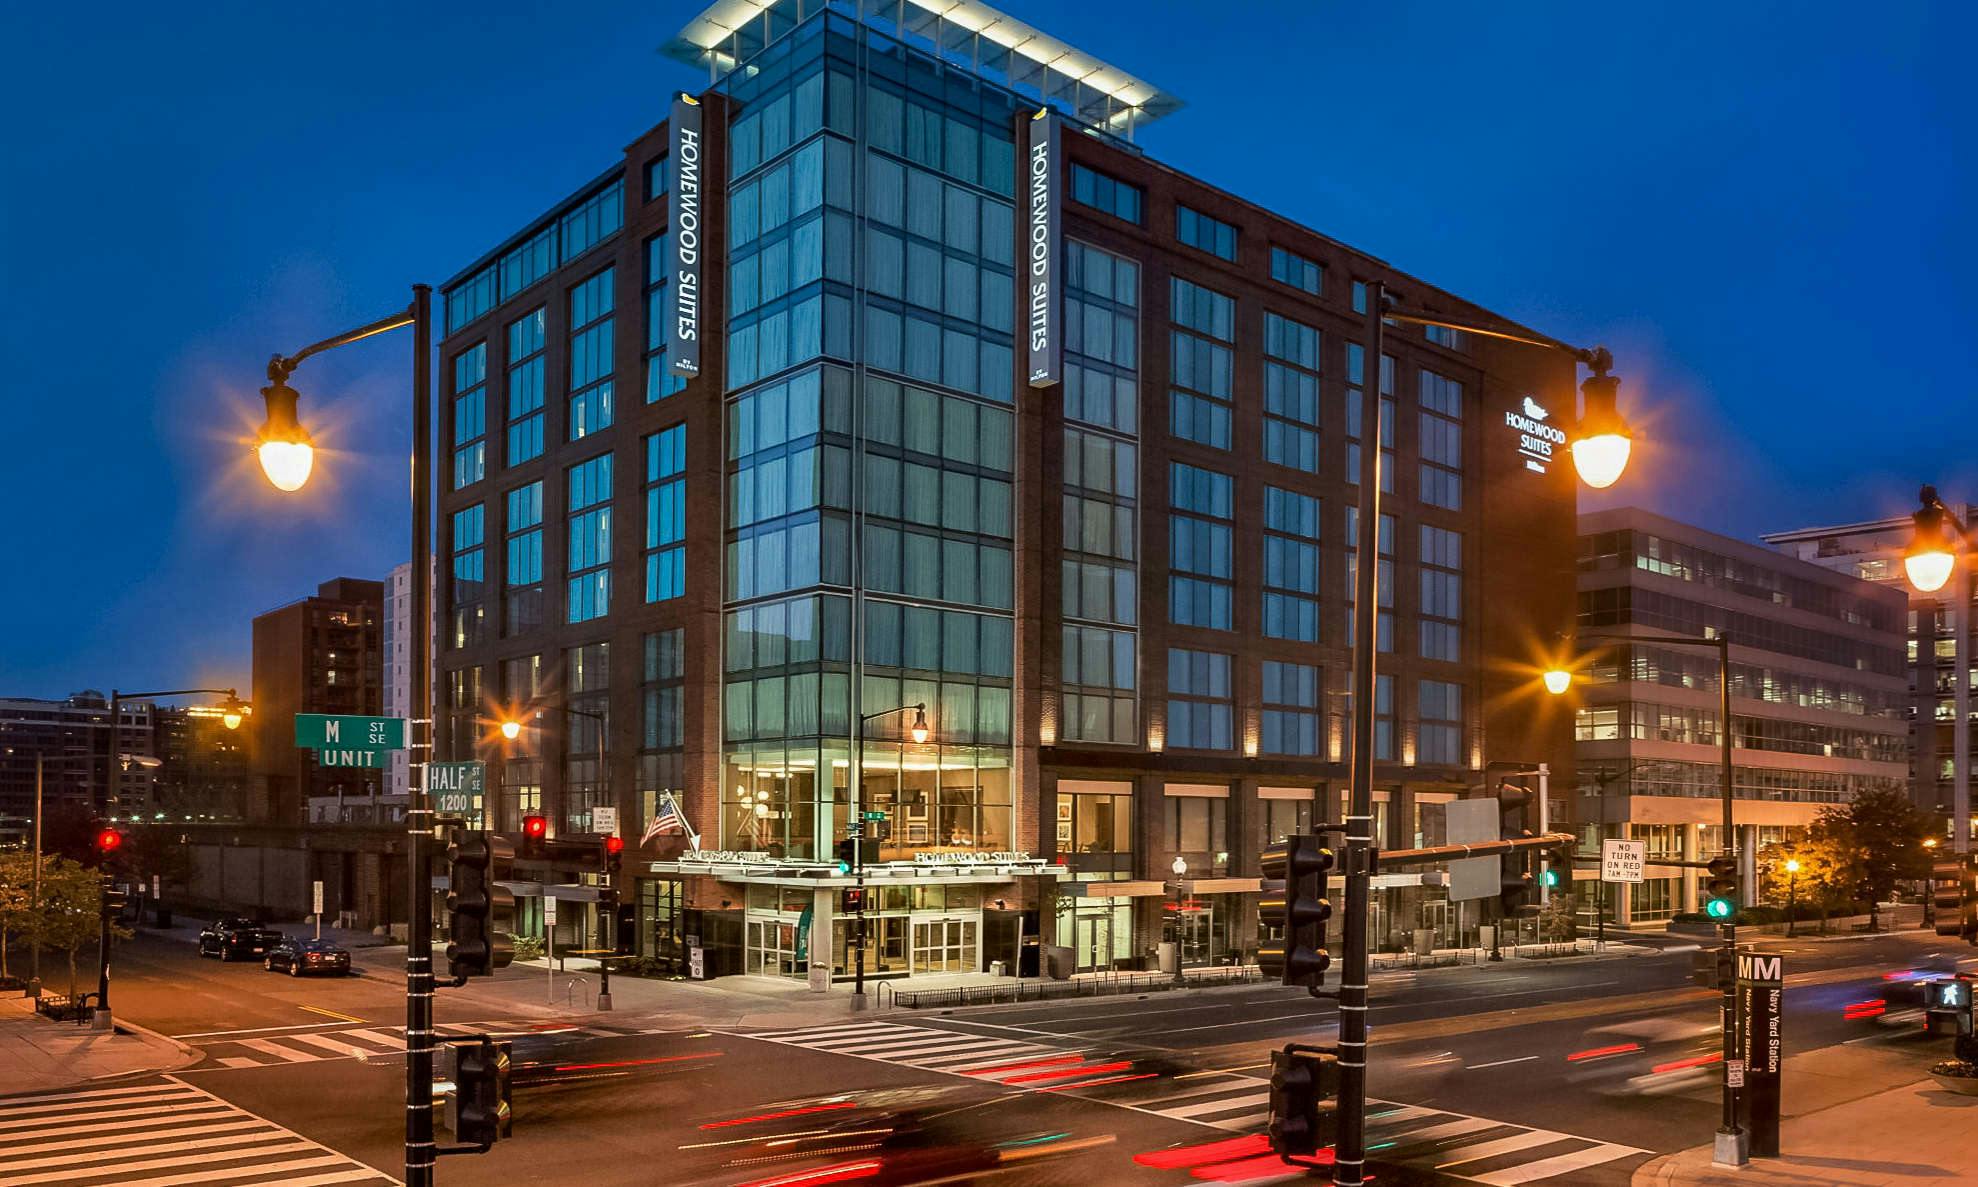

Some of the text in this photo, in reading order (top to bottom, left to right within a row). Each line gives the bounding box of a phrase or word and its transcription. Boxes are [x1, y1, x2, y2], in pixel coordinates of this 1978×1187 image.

[678, 127, 698, 341] HOMEWOOD SUITES
[1032, 141, 1047, 352] HOMEWOOD SUITES
[1505, 411, 1566, 444] HOMEWOOD
[1520, 434, 1552, 456] SUITES
[326, 720, 385, 743] M ST
[369, 733, 386, 744] SE
[324, 750, 375, 767] UNIT
[430, 767, 480, 790] HALF ST
[472, 780, 481, 790] SE
[440, 794, 467, 811] 1200
[1612, 852, 1638, 860] TURN
[1618, 843, 1631, 851] NO
[1607, 861, 1619, 869] ON
[1738, 955, 1752, 979] M
[1753, 957, 1781, 980] M
[1768, 989, 1780, 1073] Navy Yard Station
